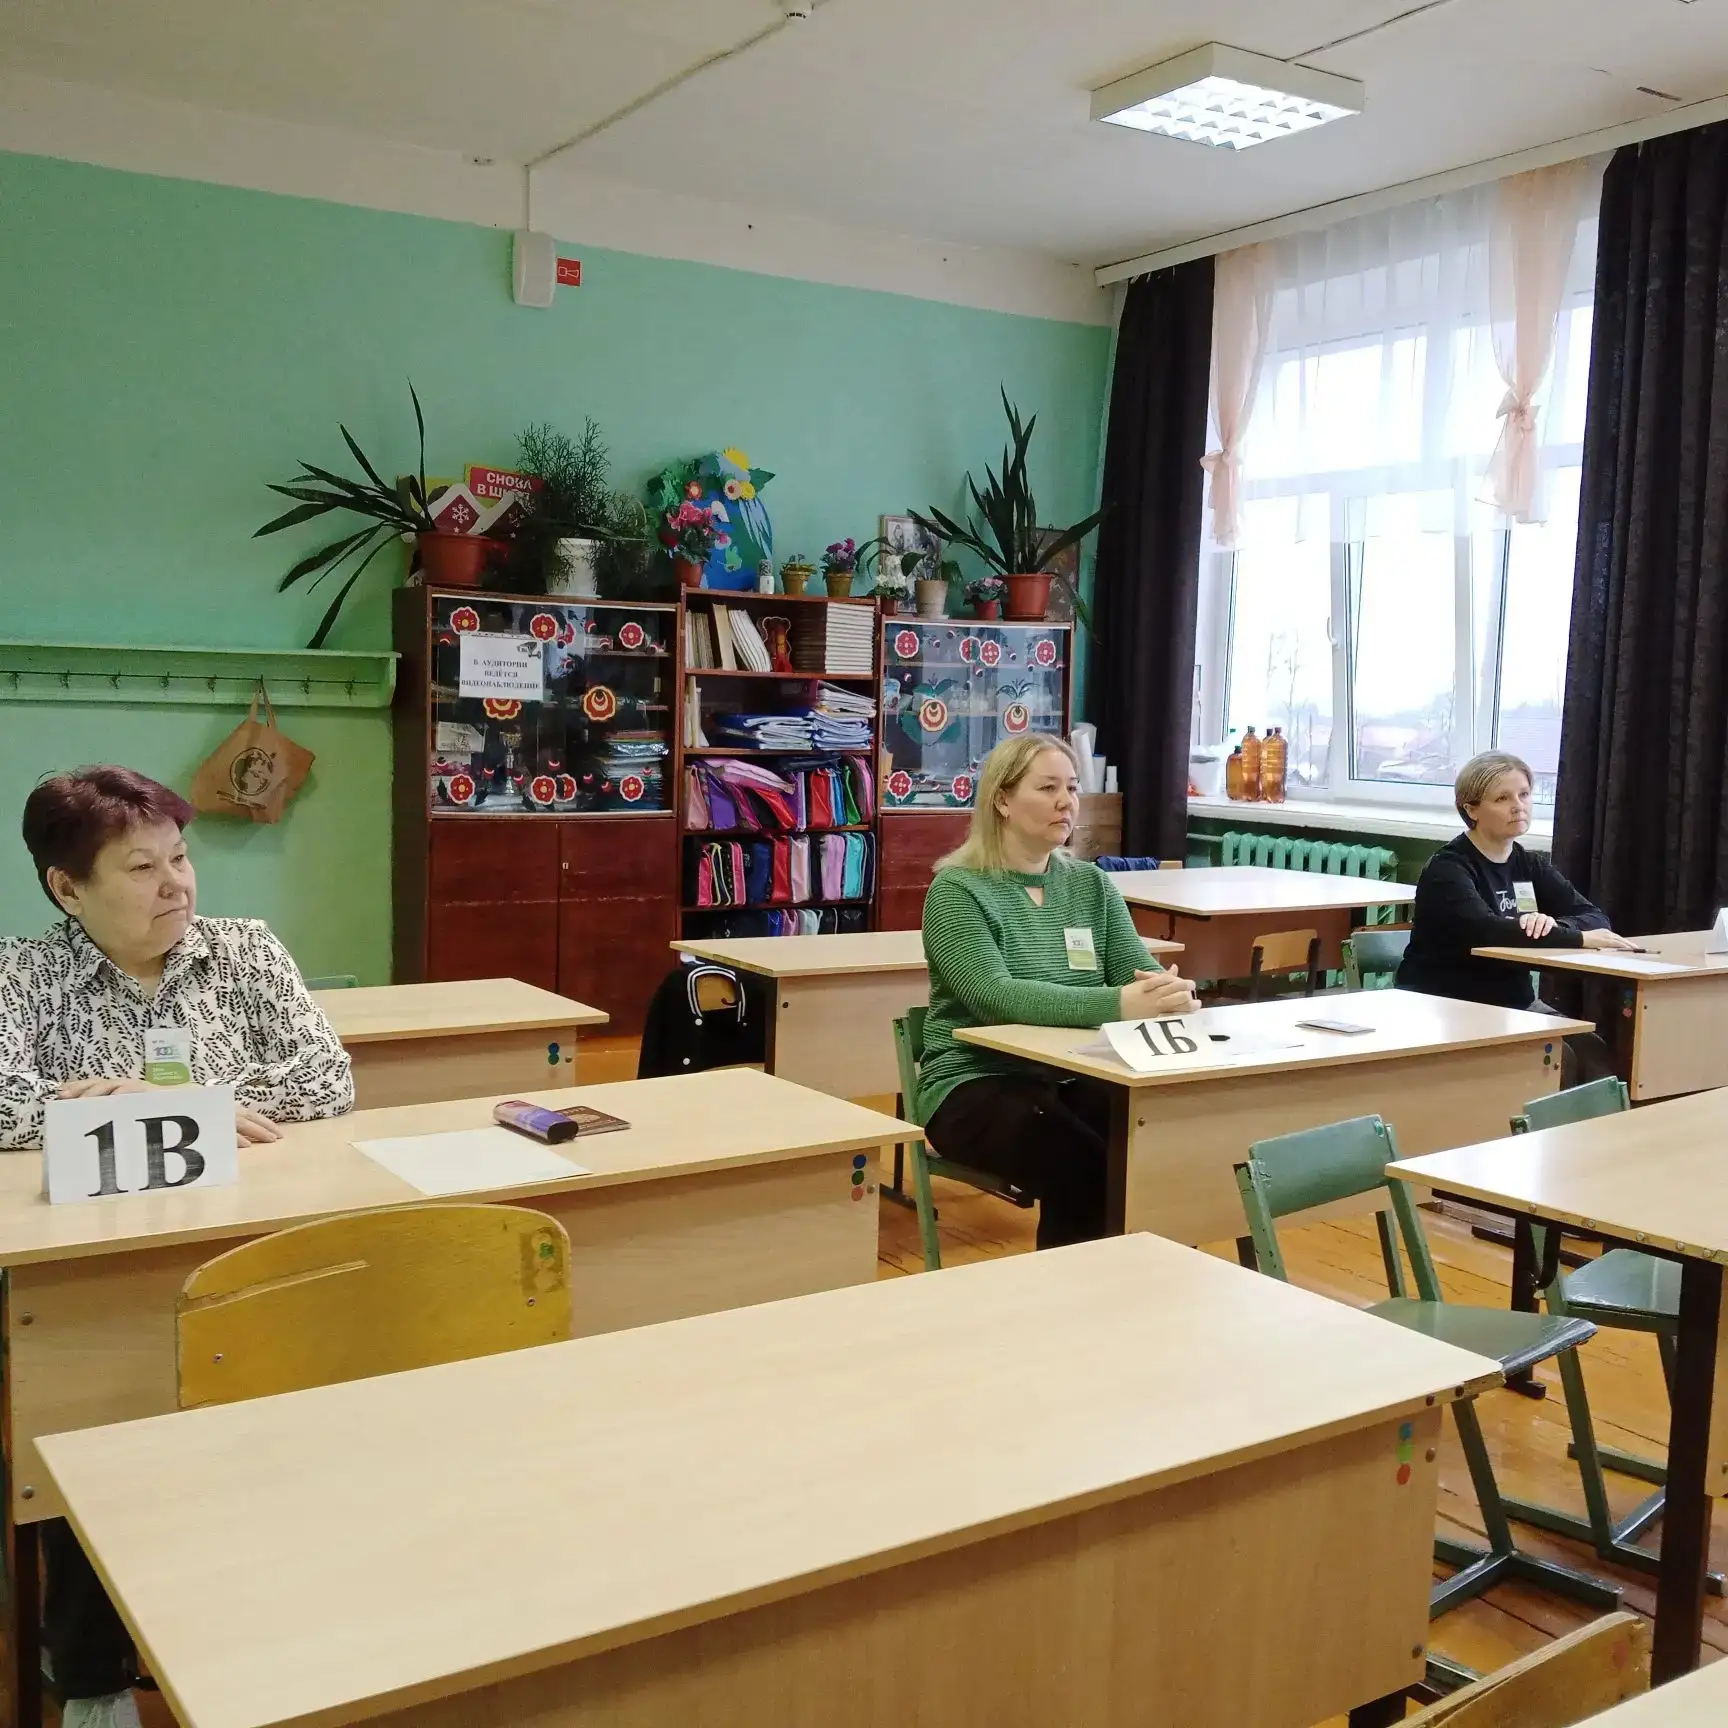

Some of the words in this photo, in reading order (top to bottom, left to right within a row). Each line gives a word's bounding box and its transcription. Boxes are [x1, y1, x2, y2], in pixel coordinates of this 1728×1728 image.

[477, 483, 486, 495] В
[482, 660, 528, 668] АУДИТОРИИ
[461, 680, 539, 689] ВИДЕОНАБЛЮДЕНИЕ
[1133, 1019, 1198, 1056] 1Б
[84, 1115, 205, 1197] 1В
